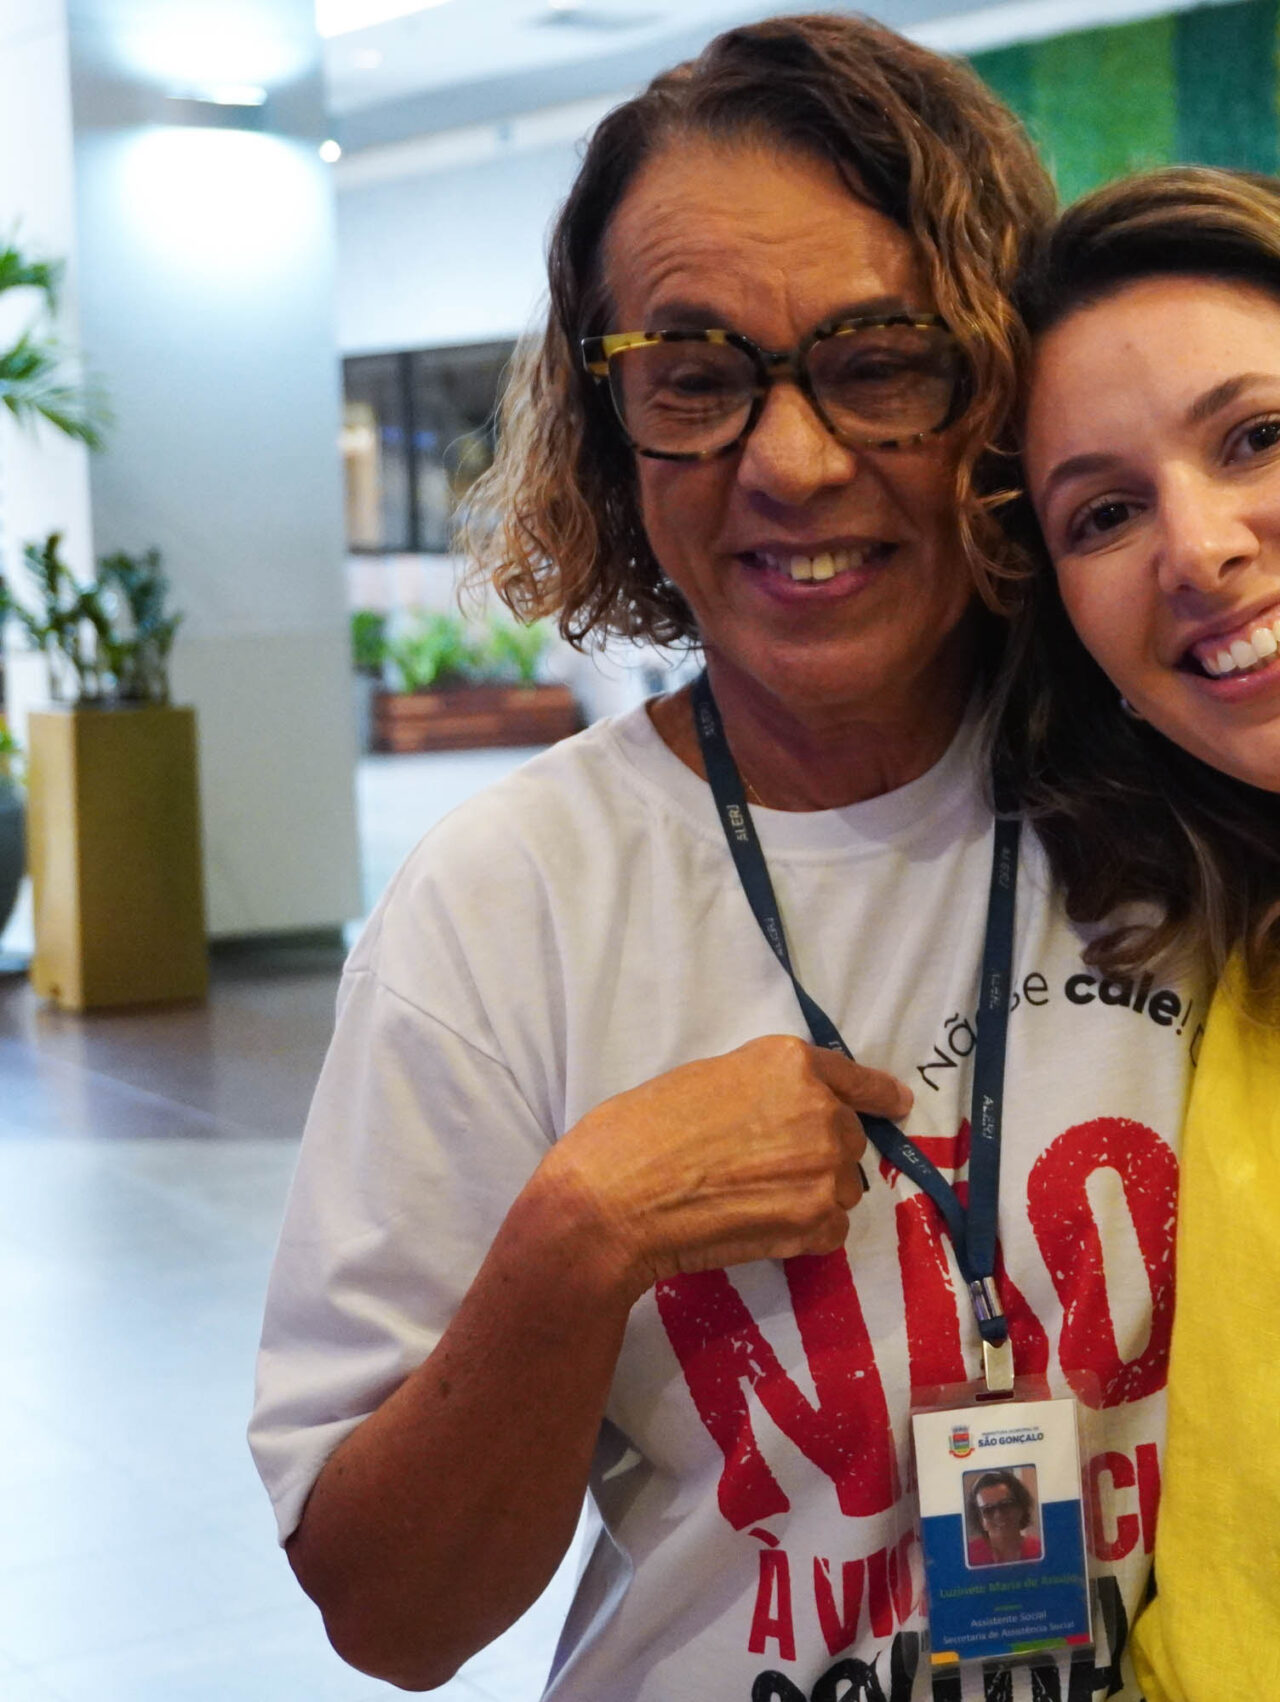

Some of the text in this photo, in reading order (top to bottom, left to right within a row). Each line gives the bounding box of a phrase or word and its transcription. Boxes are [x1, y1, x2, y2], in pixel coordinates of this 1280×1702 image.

[917, 1005, 978, 1091] Nã
[1064, 972, 1192, 1036] cale!
[656, 1117, 1179, 1530] NÃO
[978, 1432, 1044, 1447] SÃO GONÇALO
[747, 1526, 797, 1661] À
